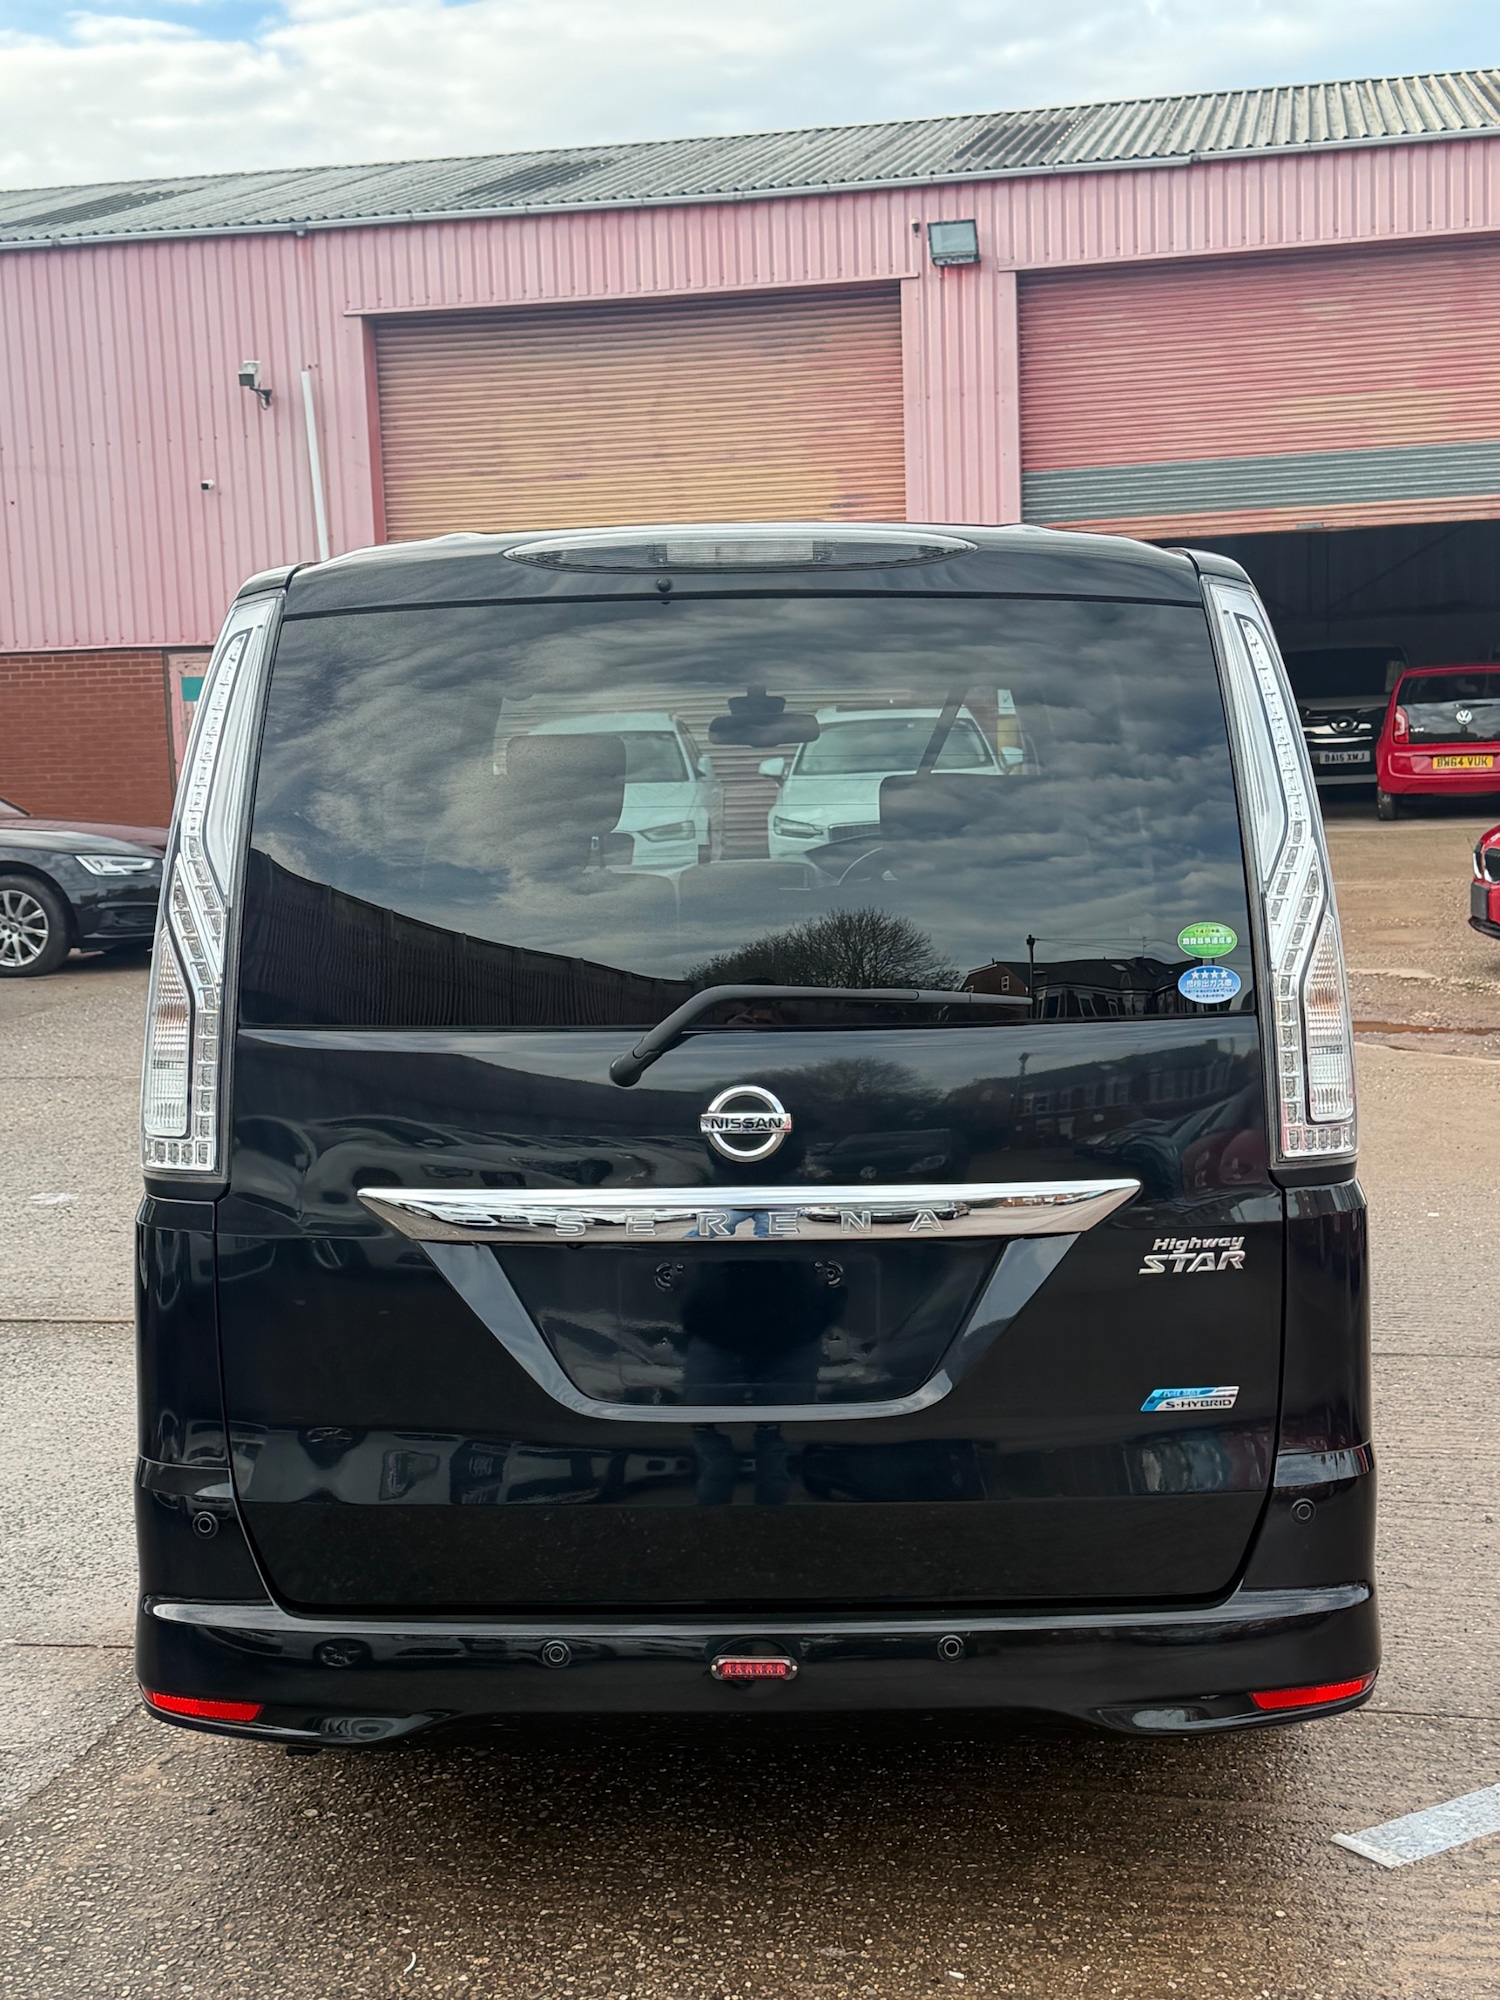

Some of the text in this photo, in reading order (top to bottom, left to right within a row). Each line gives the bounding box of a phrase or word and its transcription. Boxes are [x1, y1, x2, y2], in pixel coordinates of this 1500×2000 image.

[1467, 756, 1489, 766] VUK
[711, 1117, 782, 1129] NISSAN
[554, 1209, 944, 1237] SERENA
[1152, 1236, 1245, 1254] Highway
[1138, 1250, 1246, 1275] STAR
